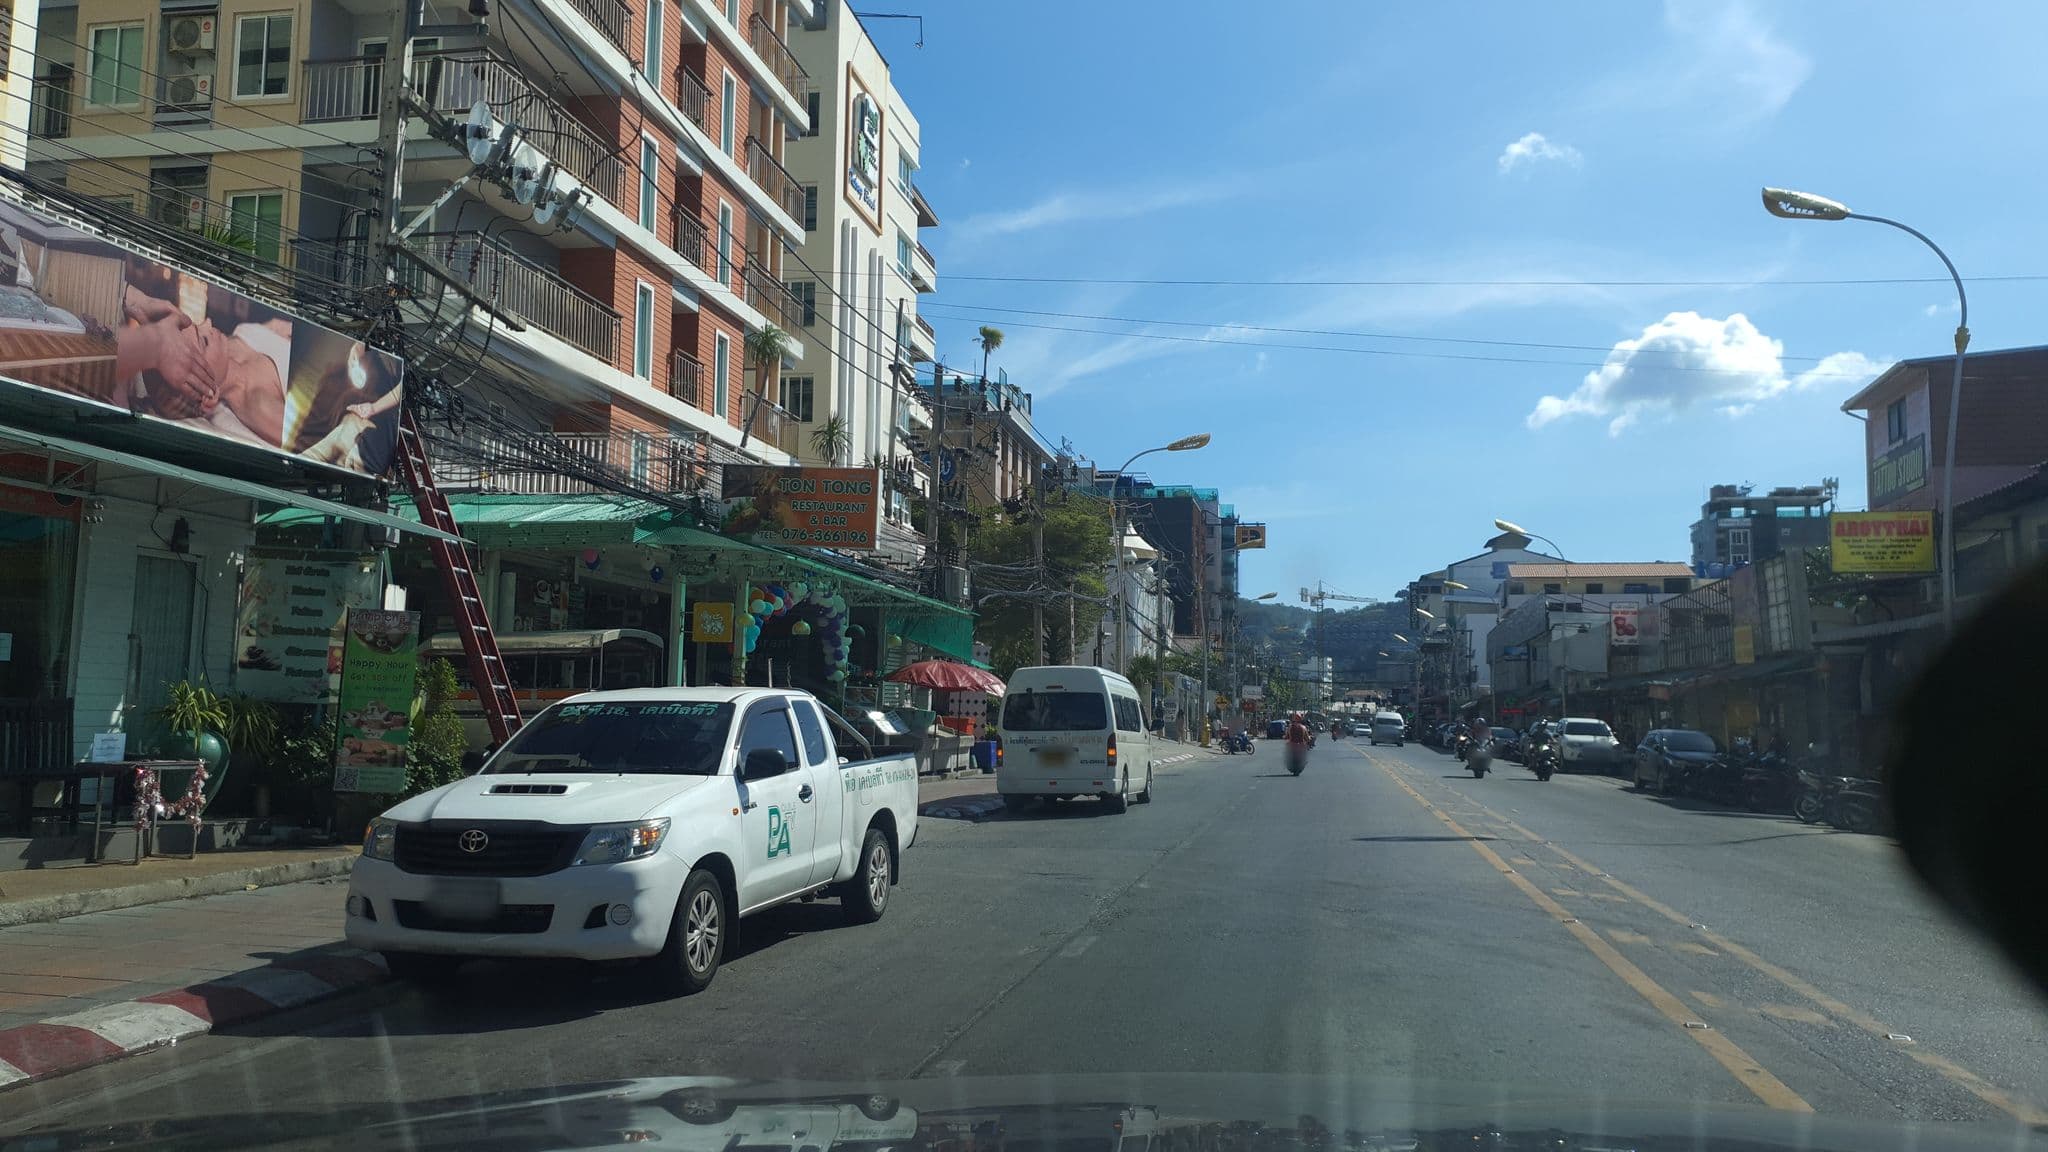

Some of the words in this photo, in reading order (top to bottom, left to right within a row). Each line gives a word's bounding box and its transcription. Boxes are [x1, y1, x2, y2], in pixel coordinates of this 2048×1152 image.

[779, 478, 816, 494] TON
[822, 479, 872, 496] TONG
[791, 500, 867, 513] RESTAURANT
[810, 516, 818, 526] &
[823, 516, 847, 526] BAR
[781, 527, 868, 544] 076-366196
